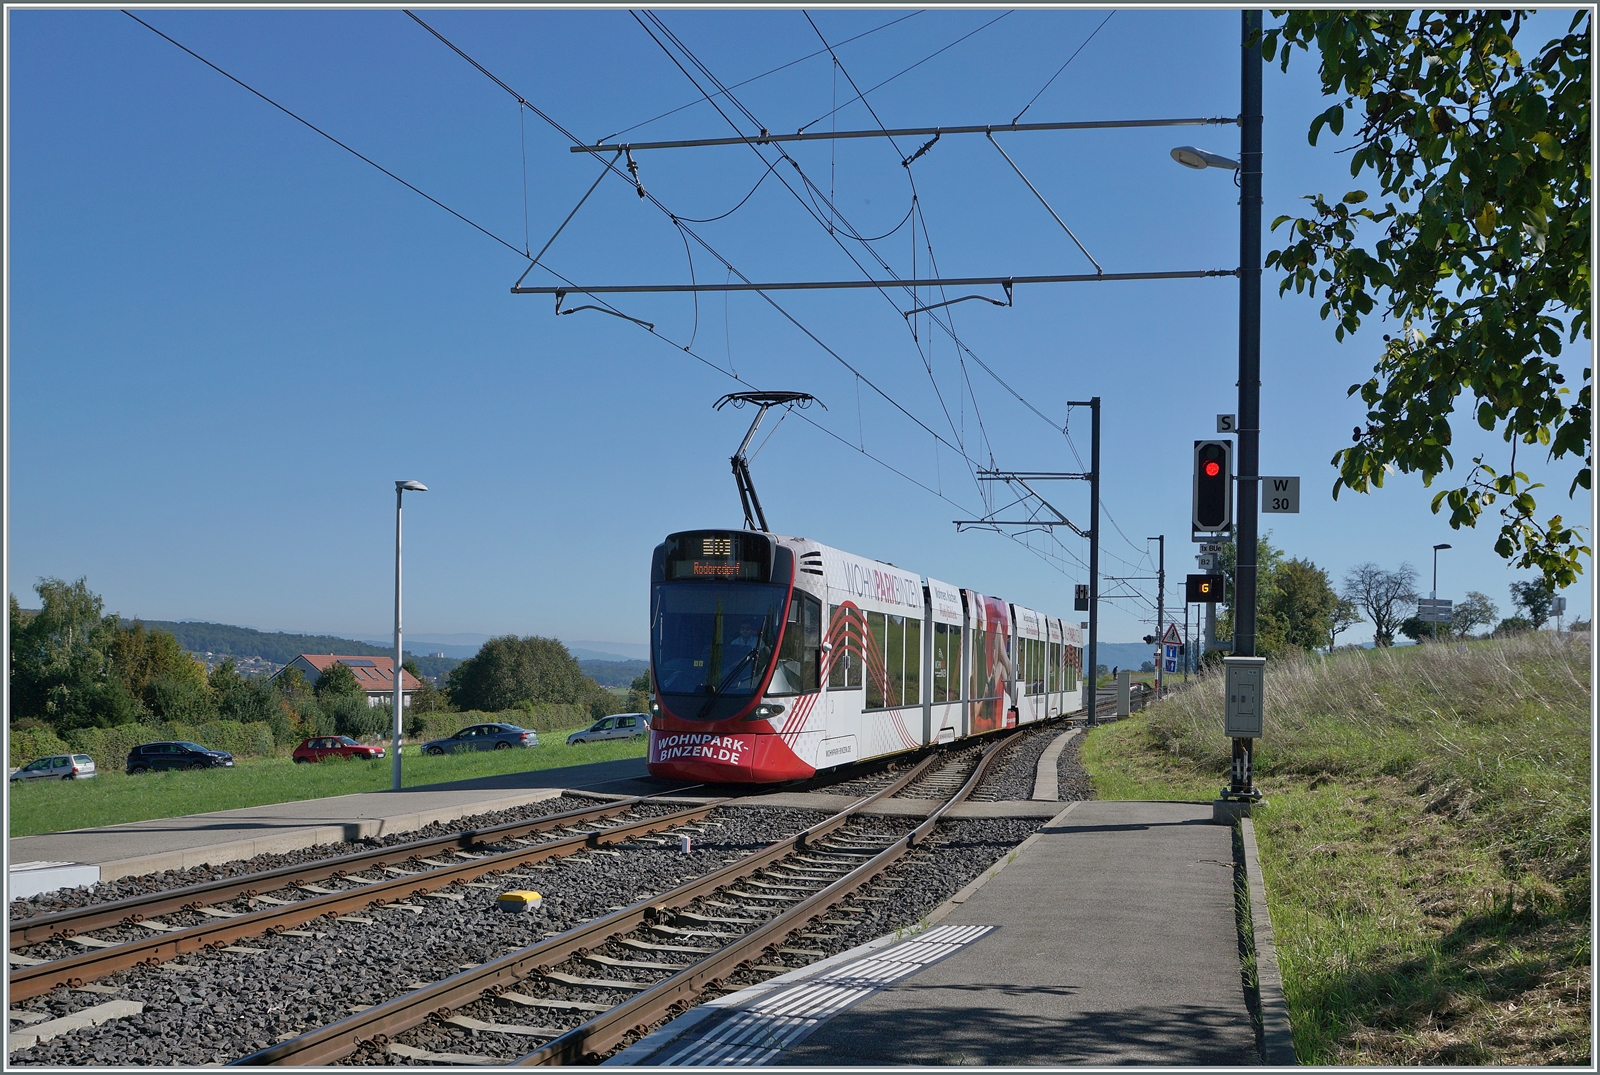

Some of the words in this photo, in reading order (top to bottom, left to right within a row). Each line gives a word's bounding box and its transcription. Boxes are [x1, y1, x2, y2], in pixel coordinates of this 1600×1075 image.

[1221, 416, 1232, 431] S
[1273, 480, 1289, 492] W
[1272, 498, 1290, 510] 30
[1201, 583, 1209, 593] G
[658, 734, 749, 752] WOHNPARK-
[660, 746, 740, 765] BINZEN.DE
